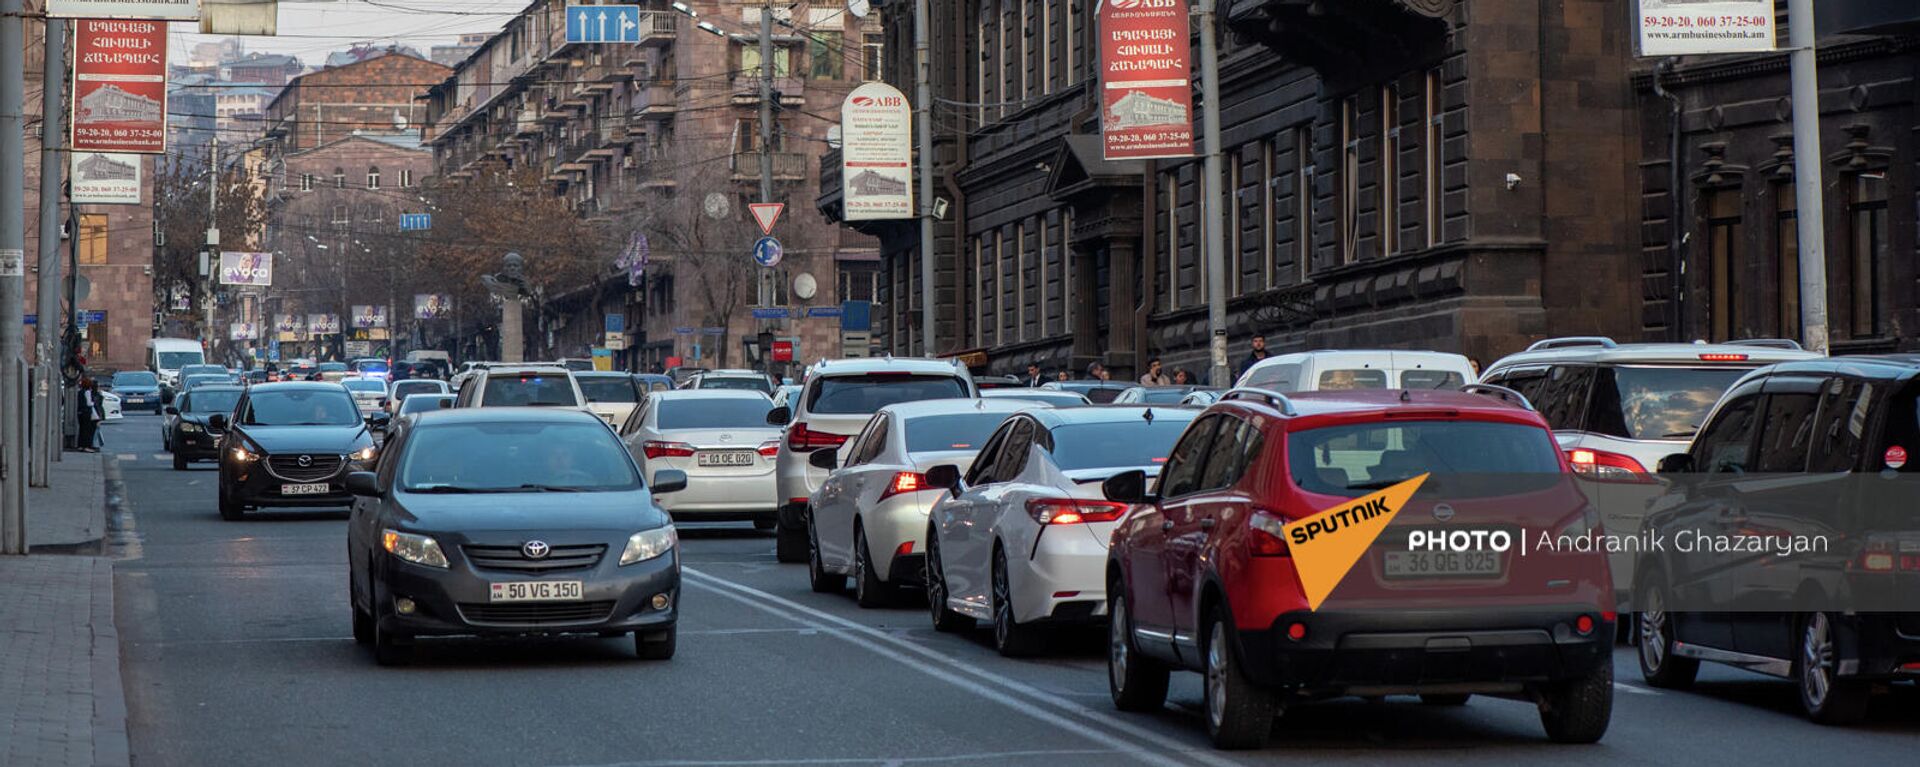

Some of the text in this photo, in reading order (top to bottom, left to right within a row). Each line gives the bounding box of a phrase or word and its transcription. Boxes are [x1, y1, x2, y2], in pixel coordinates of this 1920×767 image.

[1645, 16, 1766, 27] 59-20-20, 060 37-25-00
[1647, 31, 1765, 39] www.armbusinessbank.am
[875, 96, 901, 107] ABB
[77, 128, 162, 138] 59-20-20, 060 37-25-00
[1108, 131, 1190, 143] 59-20-20, 060 37-25-00
[223, 267, 268, 279] evoca
[1409, 553, 1495, 572] 36 QG 825
[509, 583, 578, 598] 50 VG 150
